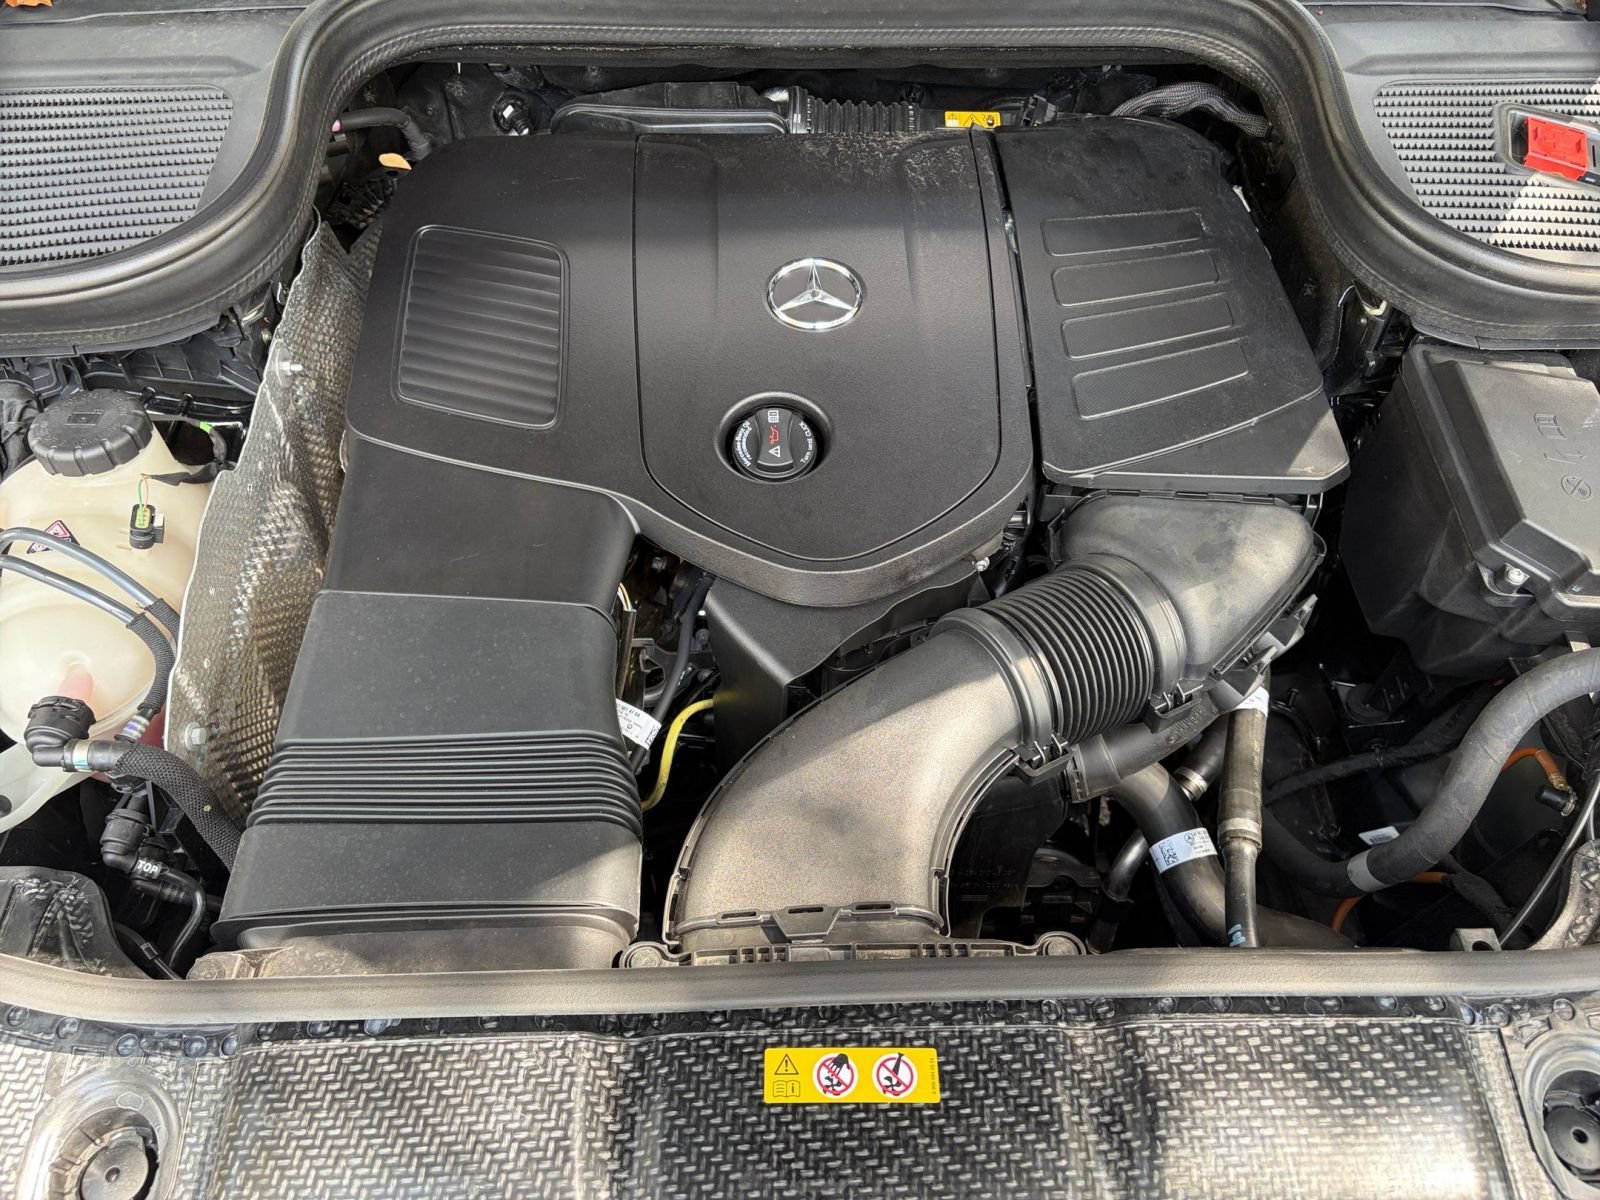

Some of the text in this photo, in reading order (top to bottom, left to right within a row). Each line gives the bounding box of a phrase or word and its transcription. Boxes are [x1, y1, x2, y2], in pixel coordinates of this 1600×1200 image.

[735, 427, 752, 467] Mercedes-Benz
[799, 451, 811, 464] Turn
[136, 859, 159, 874] TOP
